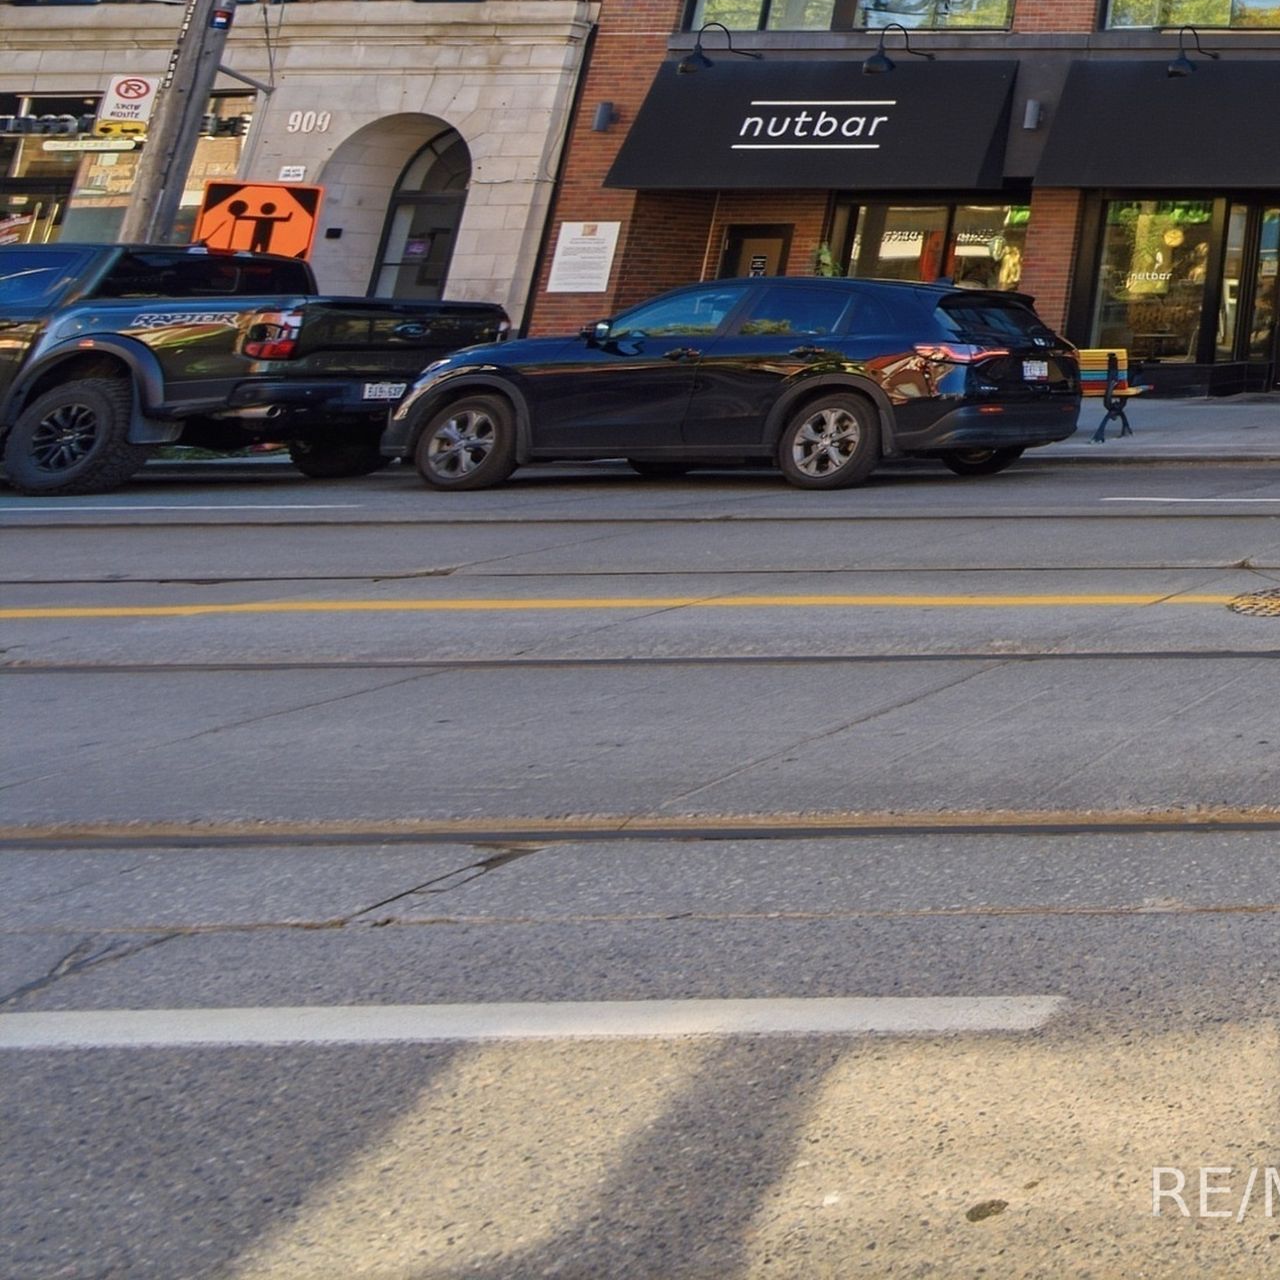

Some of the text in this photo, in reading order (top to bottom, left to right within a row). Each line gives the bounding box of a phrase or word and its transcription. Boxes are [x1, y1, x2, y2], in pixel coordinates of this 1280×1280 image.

[286, 111, 331, 133] 909
[739, 111, 889, 137] nutbar
[1131, 271, 1172, 281] nutbar
